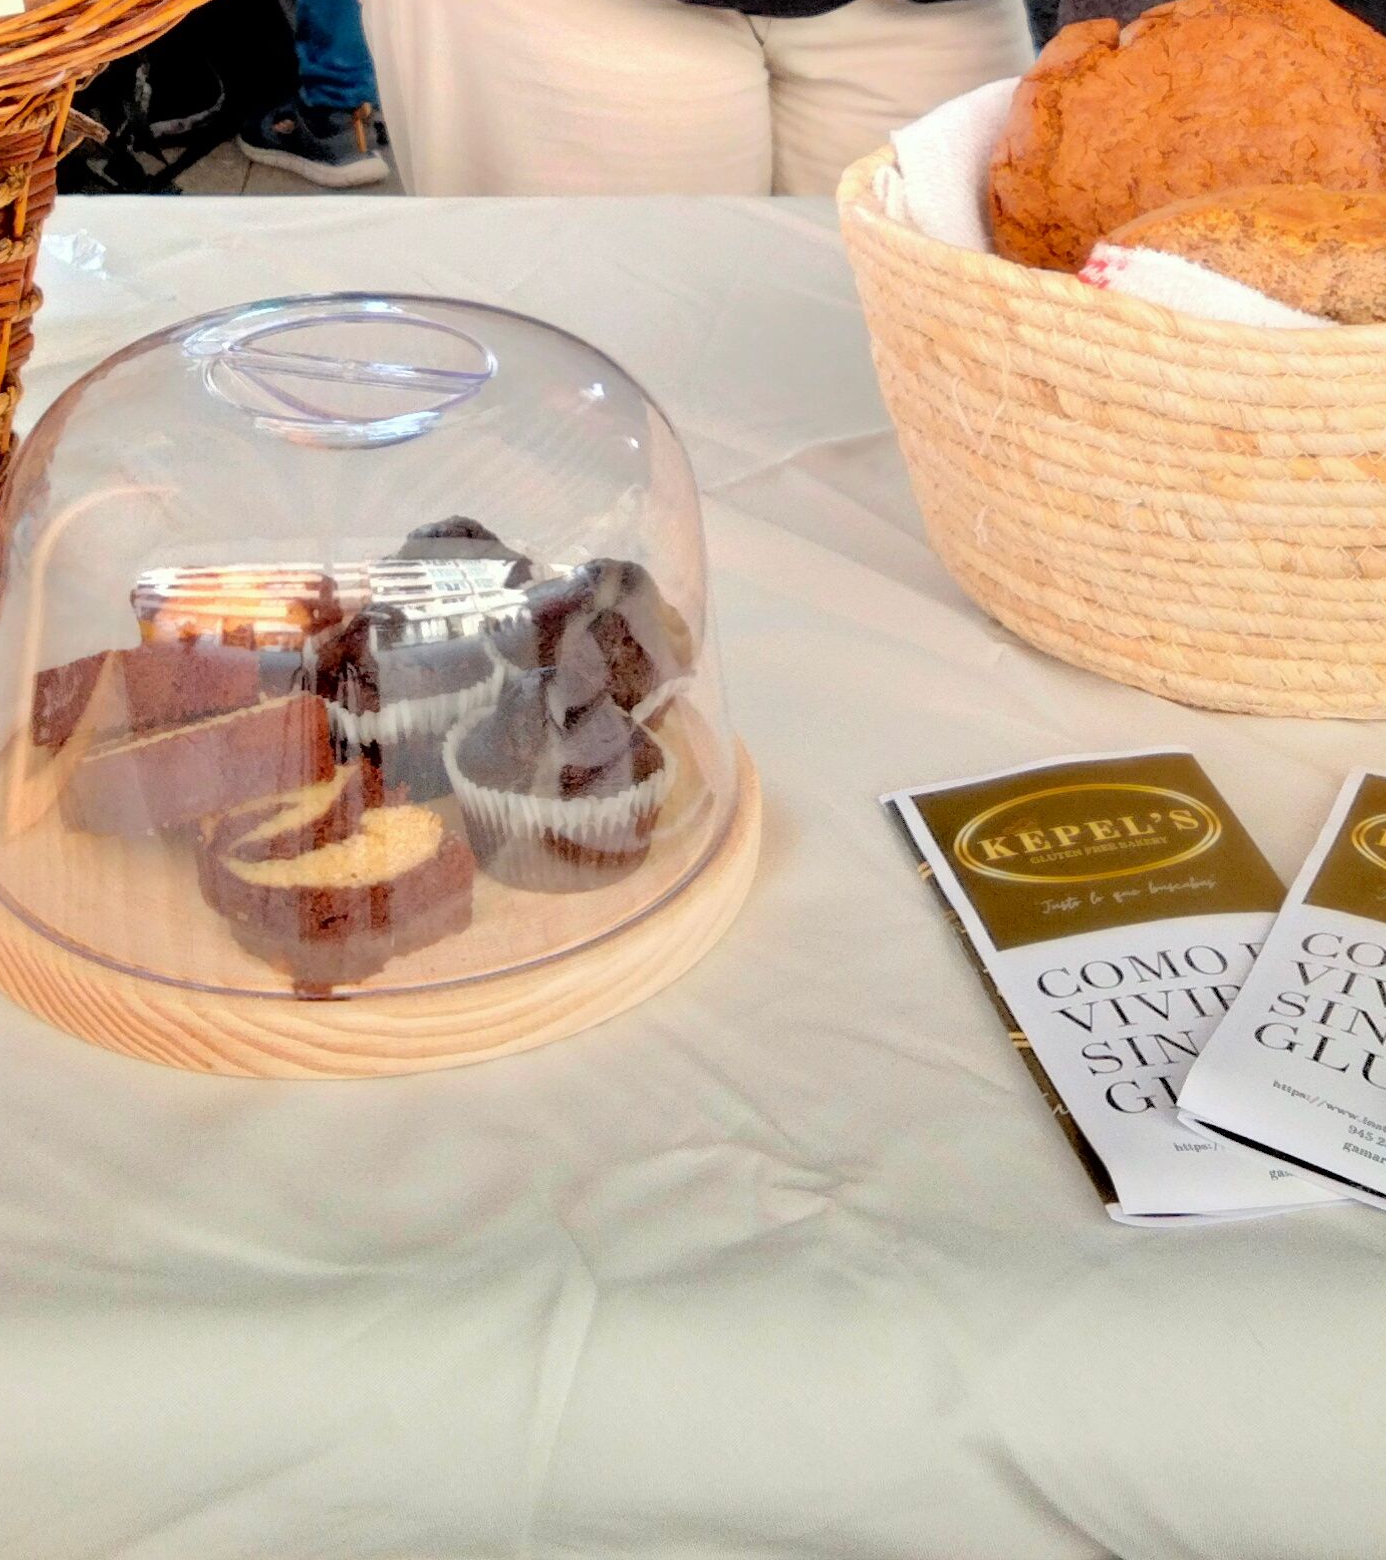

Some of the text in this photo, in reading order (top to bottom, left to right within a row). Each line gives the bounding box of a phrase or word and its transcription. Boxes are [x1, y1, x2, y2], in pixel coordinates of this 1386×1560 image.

[976, 809, 1200, 862] KEPEL'S
[1029, 849, 1083, 865] GLUTEN
[1037, 944, 1229, 999] COMO
[1081, 1030, 1201, 1077] SIN
[1348, 1124, 1374, 1143] 945
